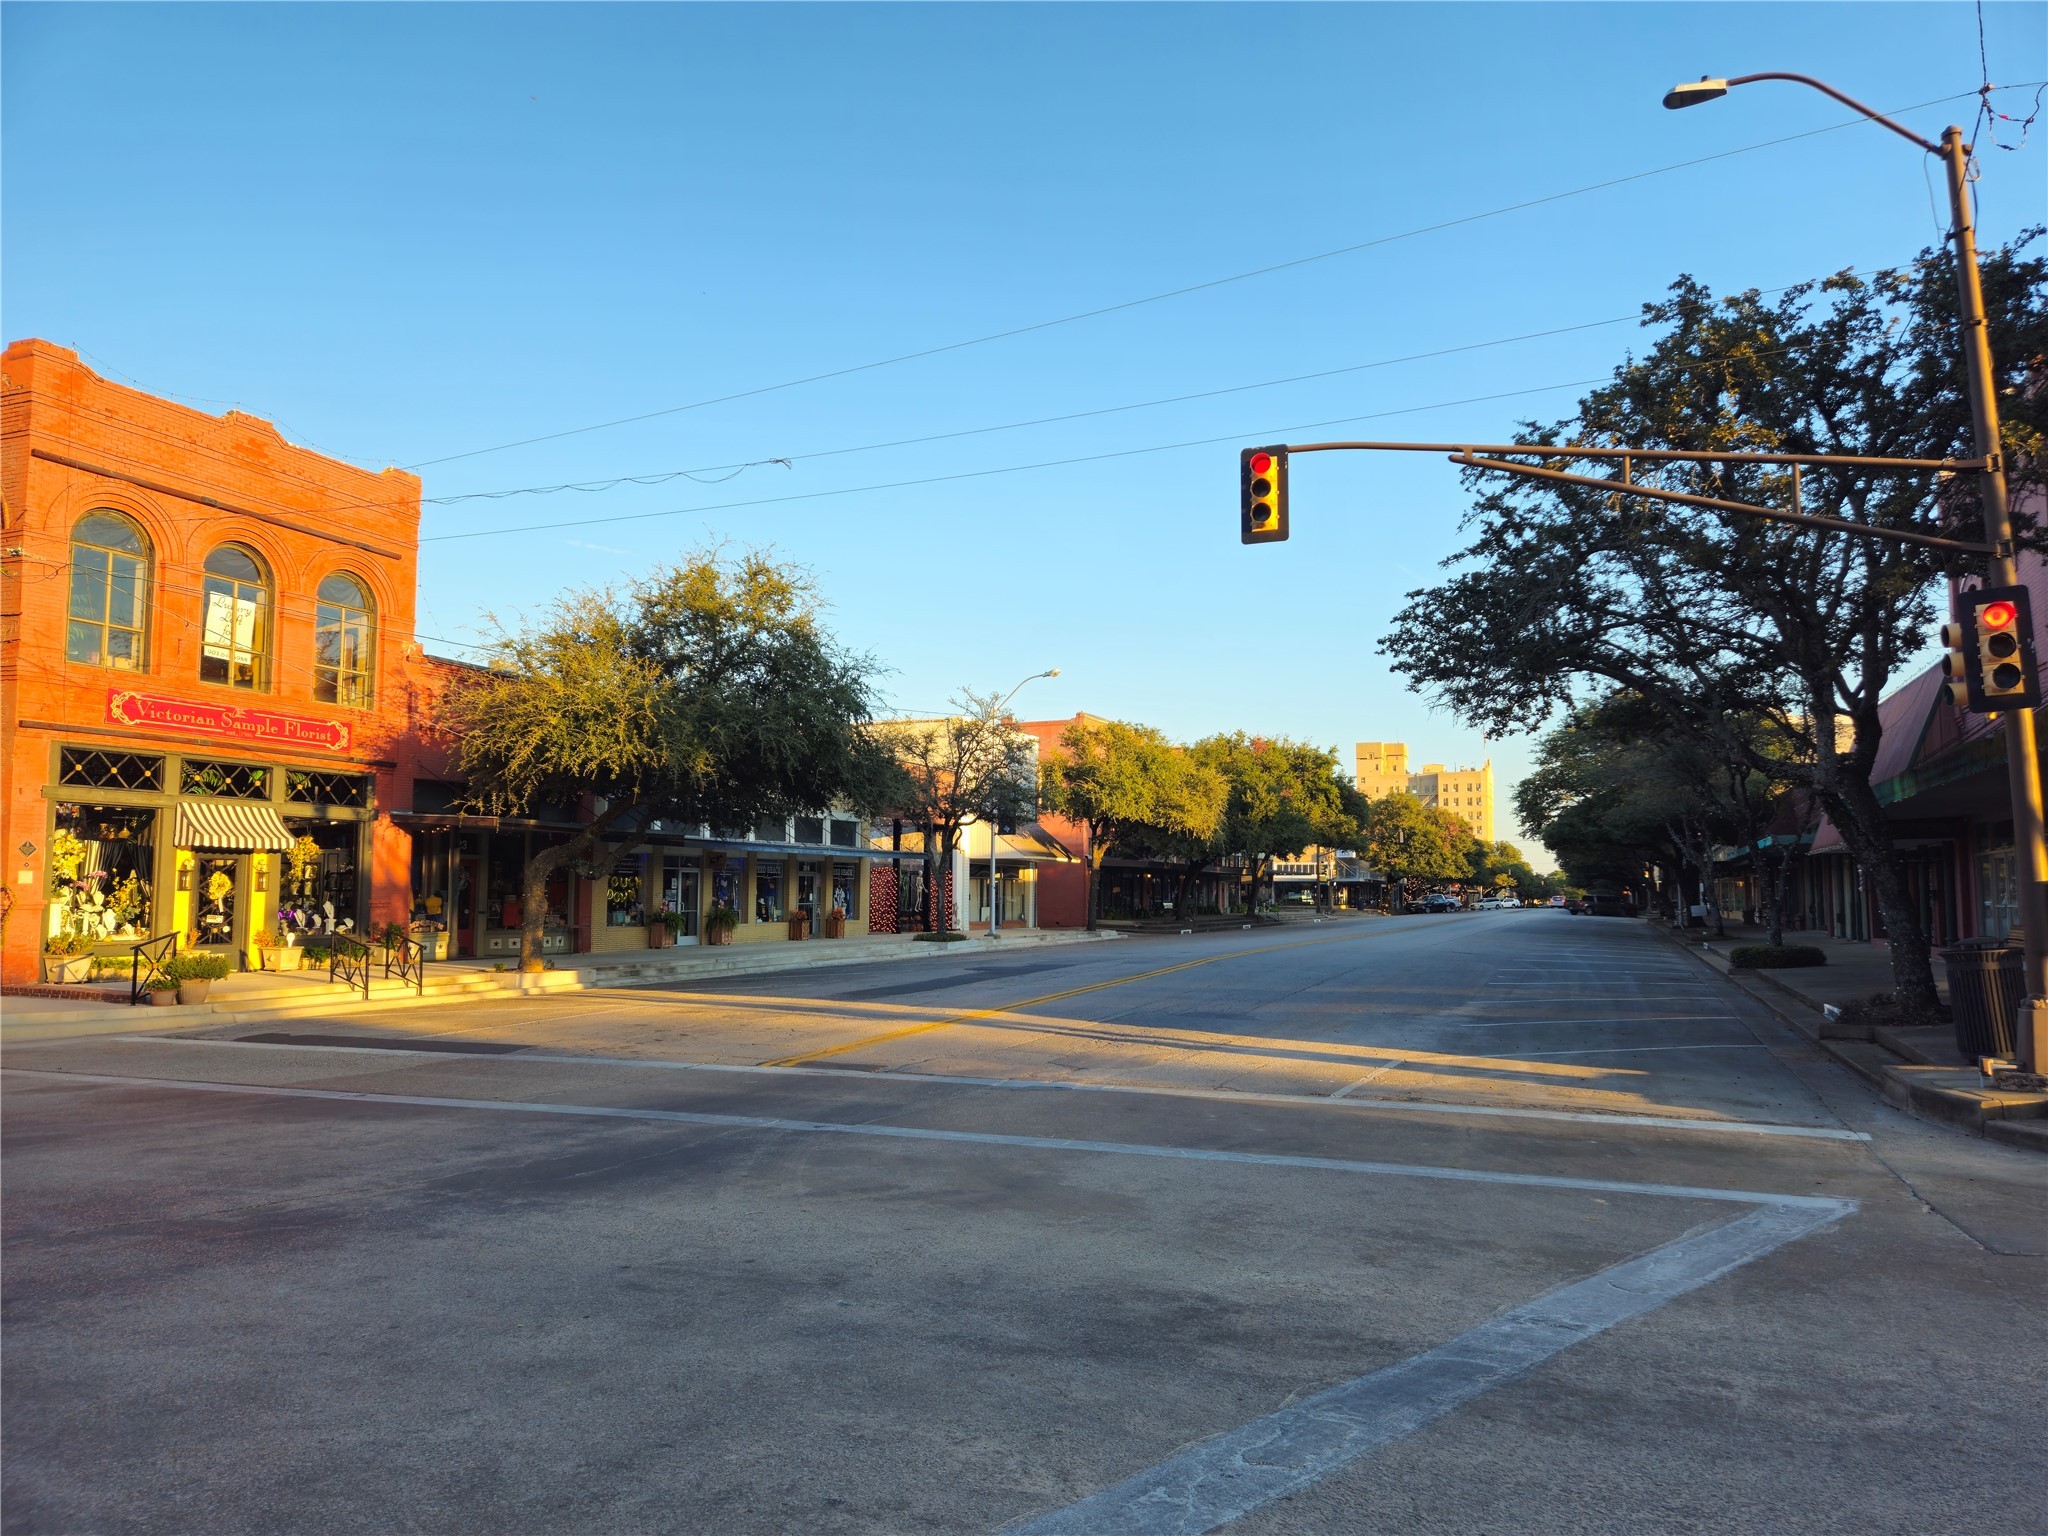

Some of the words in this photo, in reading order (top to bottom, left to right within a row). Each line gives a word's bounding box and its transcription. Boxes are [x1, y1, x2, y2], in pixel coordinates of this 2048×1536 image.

[134, 699, 216, 727] Victorian
[220, 710, 279, 737] Sample
[284, 719, 332, 742] Florist
